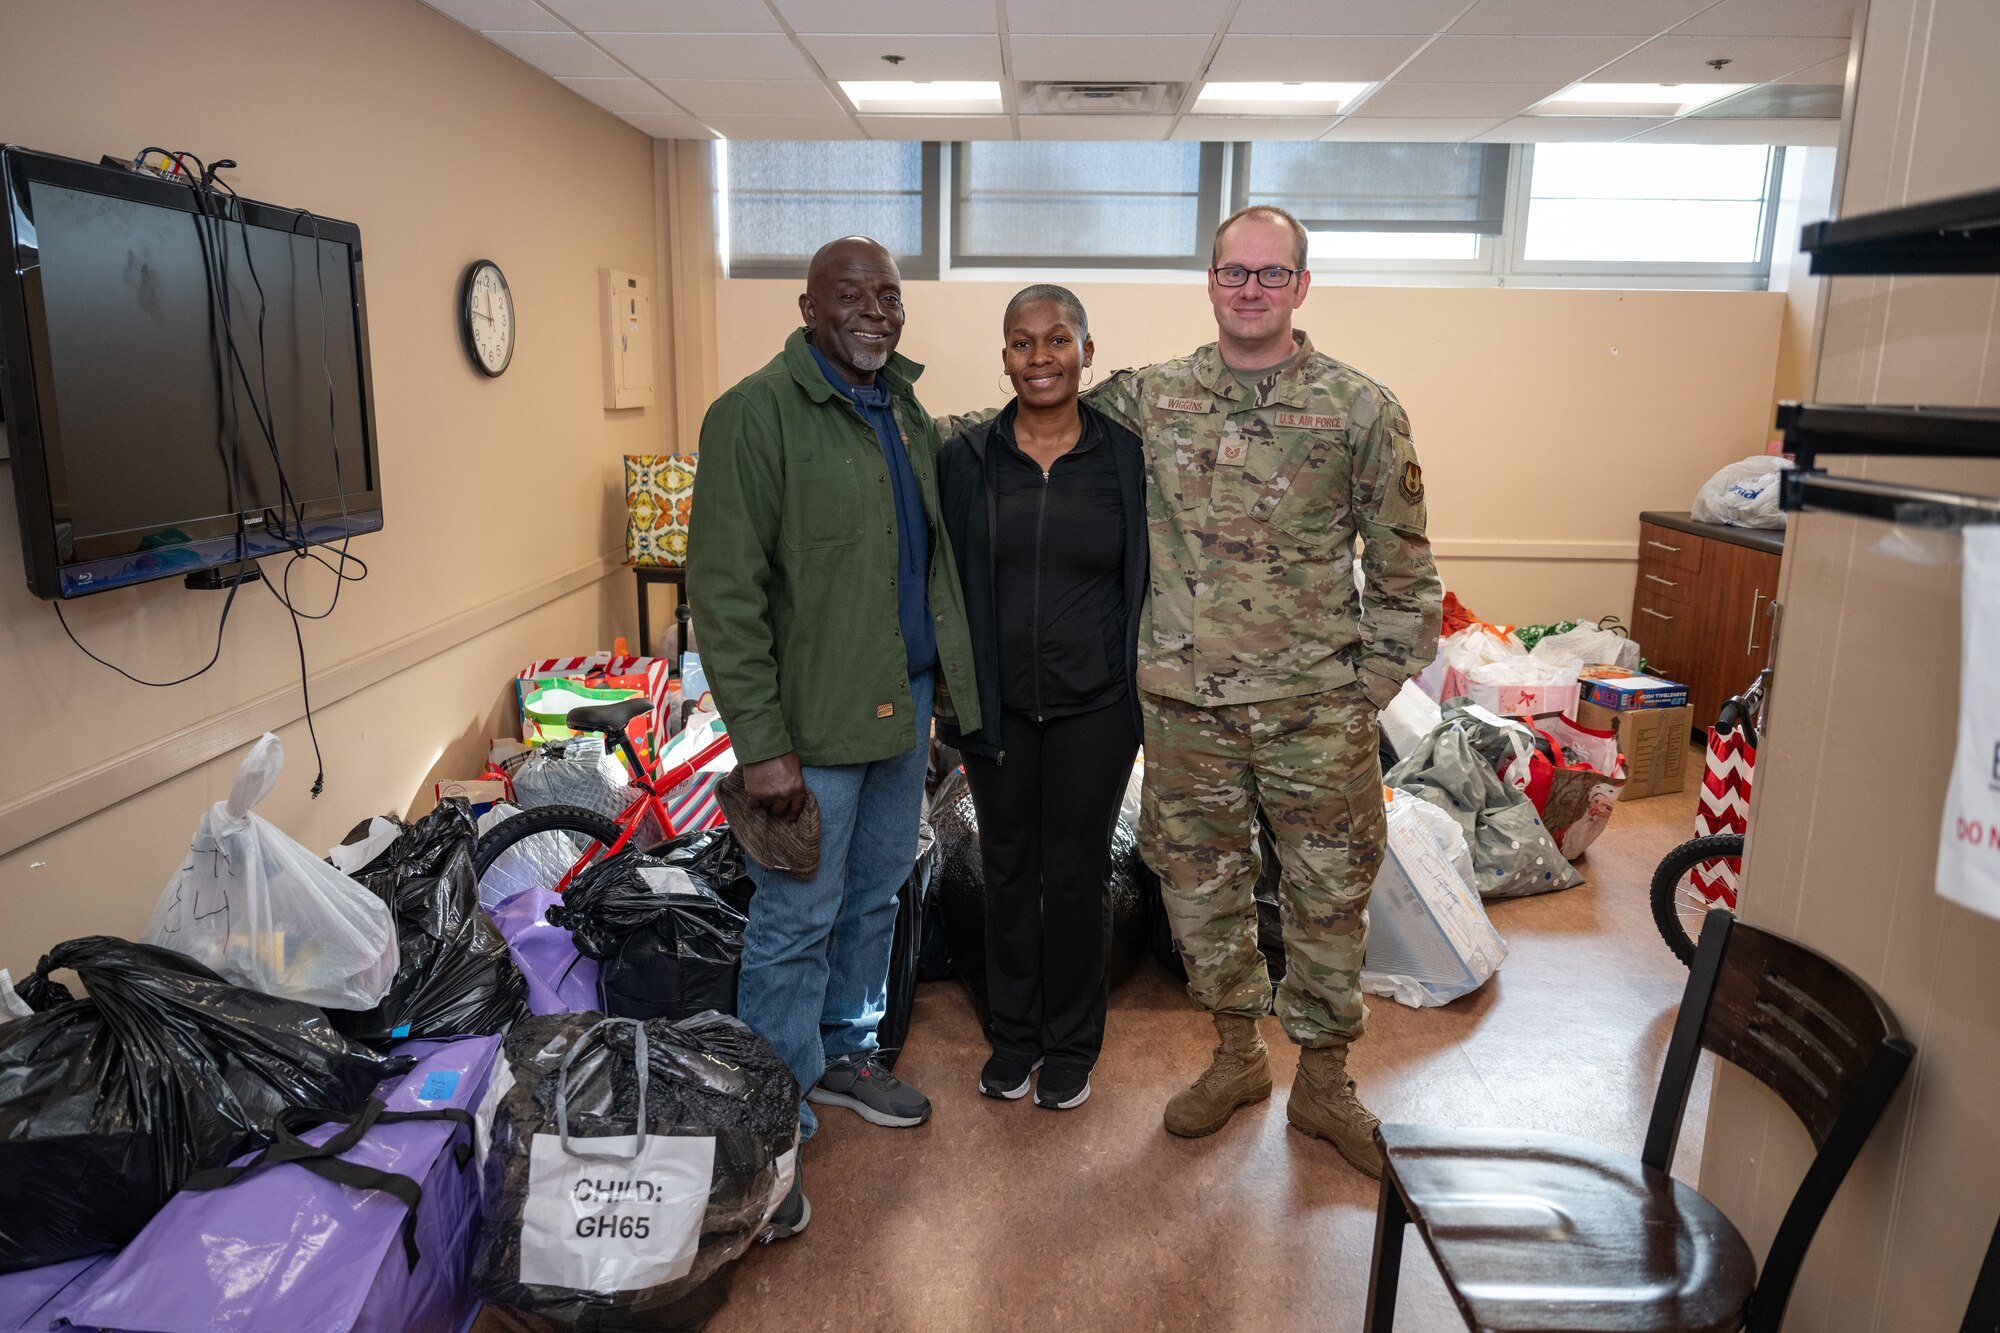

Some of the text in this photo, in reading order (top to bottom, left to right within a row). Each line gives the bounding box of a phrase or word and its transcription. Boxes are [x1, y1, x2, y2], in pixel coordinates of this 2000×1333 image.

[499, 297, 504, 310] 2
[501, 315, 507, 327] 3
[475, 329, 480, 342] 8
[500, 331, 505, 342] 4
[482, 344, 487, 357] 7
[489, 351, 494, 363] 6
[496, 345, 502, 358] 5
[1168, 399, 1202, 411] WIGGINS
[1279, 413, 1342, 428] U.S. AIR FORCE
[1956, 816, 1983, 846] DO
[574, 1178, 662, 1203] CHILD:
[575, 1215, 651, 1239] GH65
